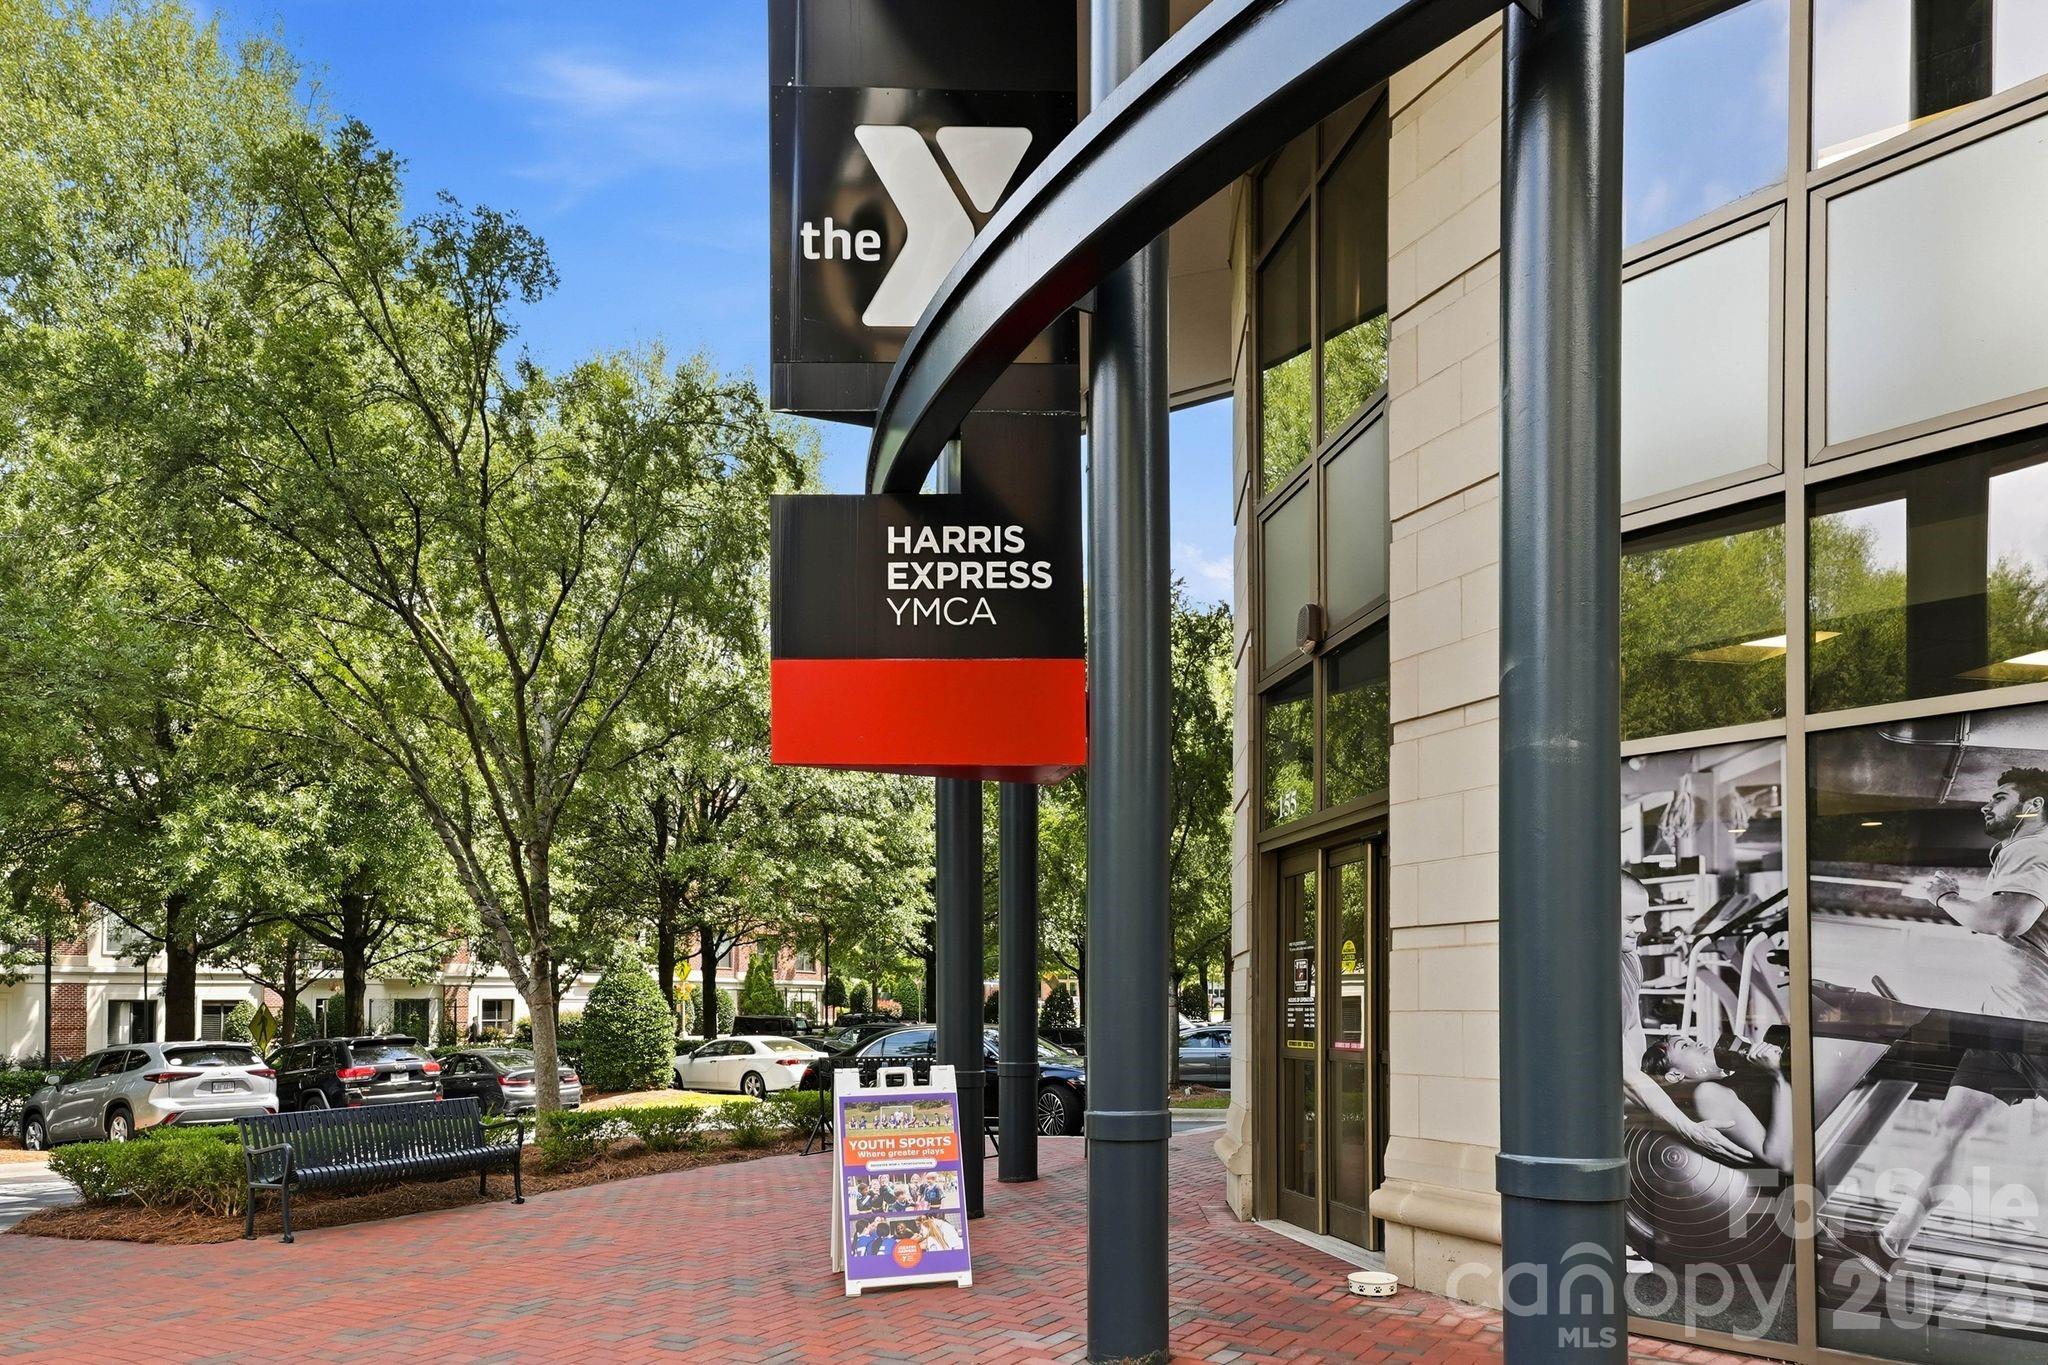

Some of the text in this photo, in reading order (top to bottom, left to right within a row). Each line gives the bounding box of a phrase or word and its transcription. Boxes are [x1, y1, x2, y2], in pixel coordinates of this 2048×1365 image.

[800, 216, 881, 262] the
[887, 525, 1026, 554] HARRIS
[887, 560, 1053, 590] EXPRESS
[886, 597, 997, 626] YMCA
[849, 1136, 952, 1151] YOUTH SPORTS
[857, 1147, 945, 1158] Where greater plays
